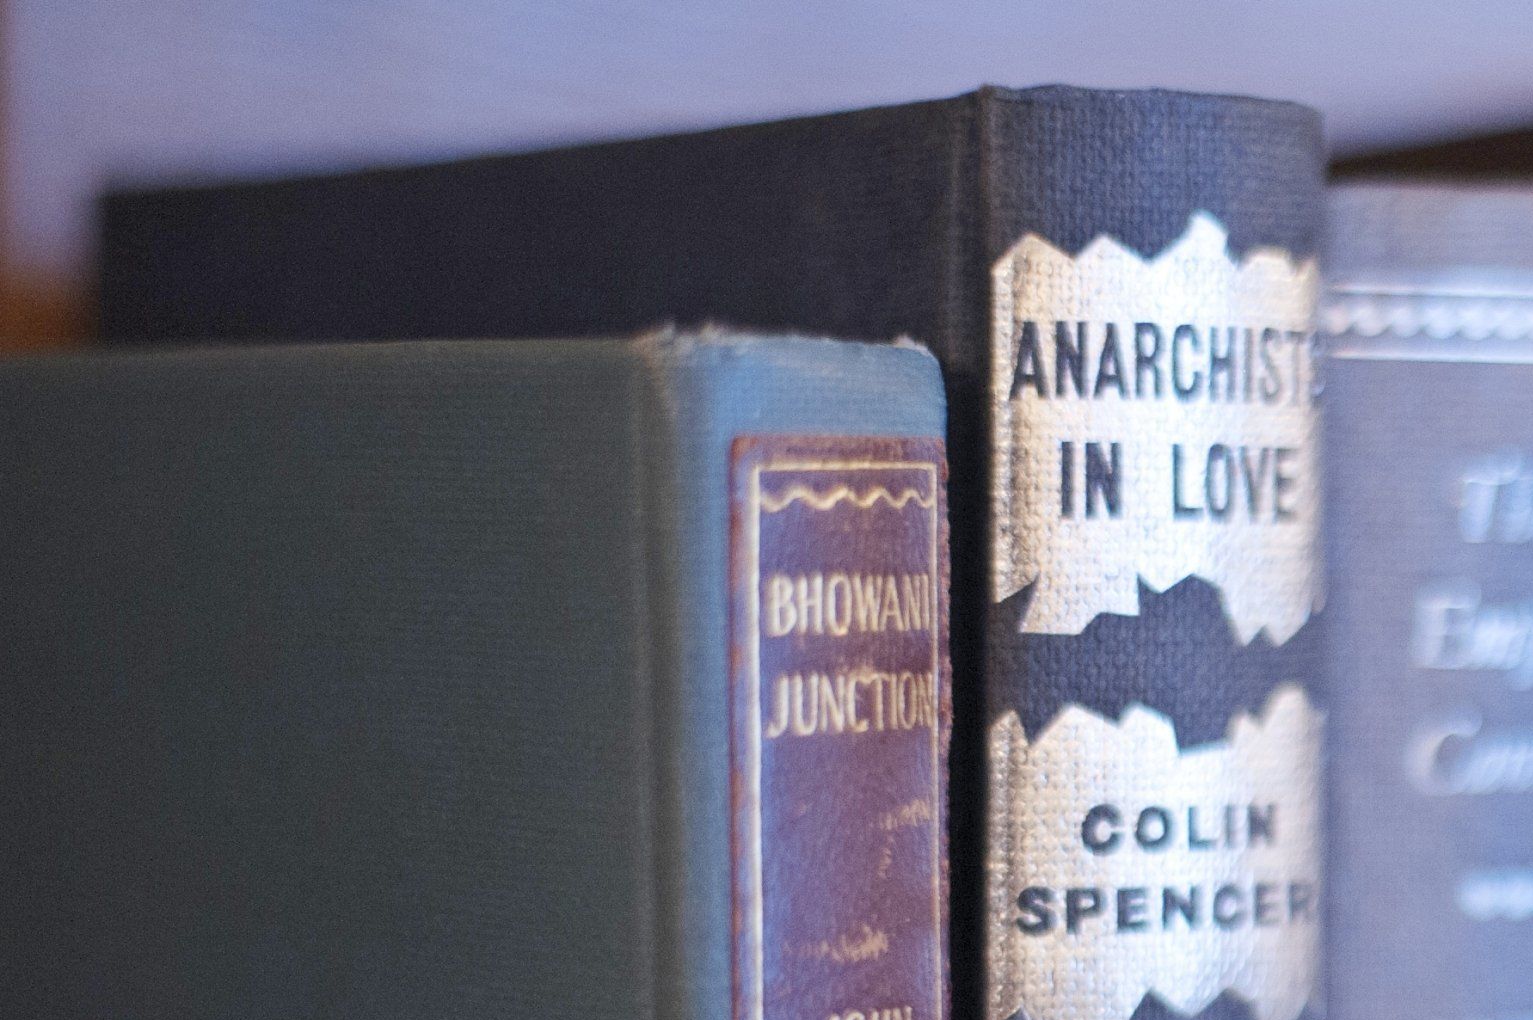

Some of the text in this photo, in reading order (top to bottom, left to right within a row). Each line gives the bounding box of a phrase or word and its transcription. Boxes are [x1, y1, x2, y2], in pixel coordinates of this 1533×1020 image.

[1059, 440, 1301, 523] IN LOVE
[766, 573, 930, 637] BHOWANI
[765, 668, 934, 739] JUNCTION
[1080, 802, 1277, 856] COLIN
[1015, 882, 1318, 936] SPENCER
